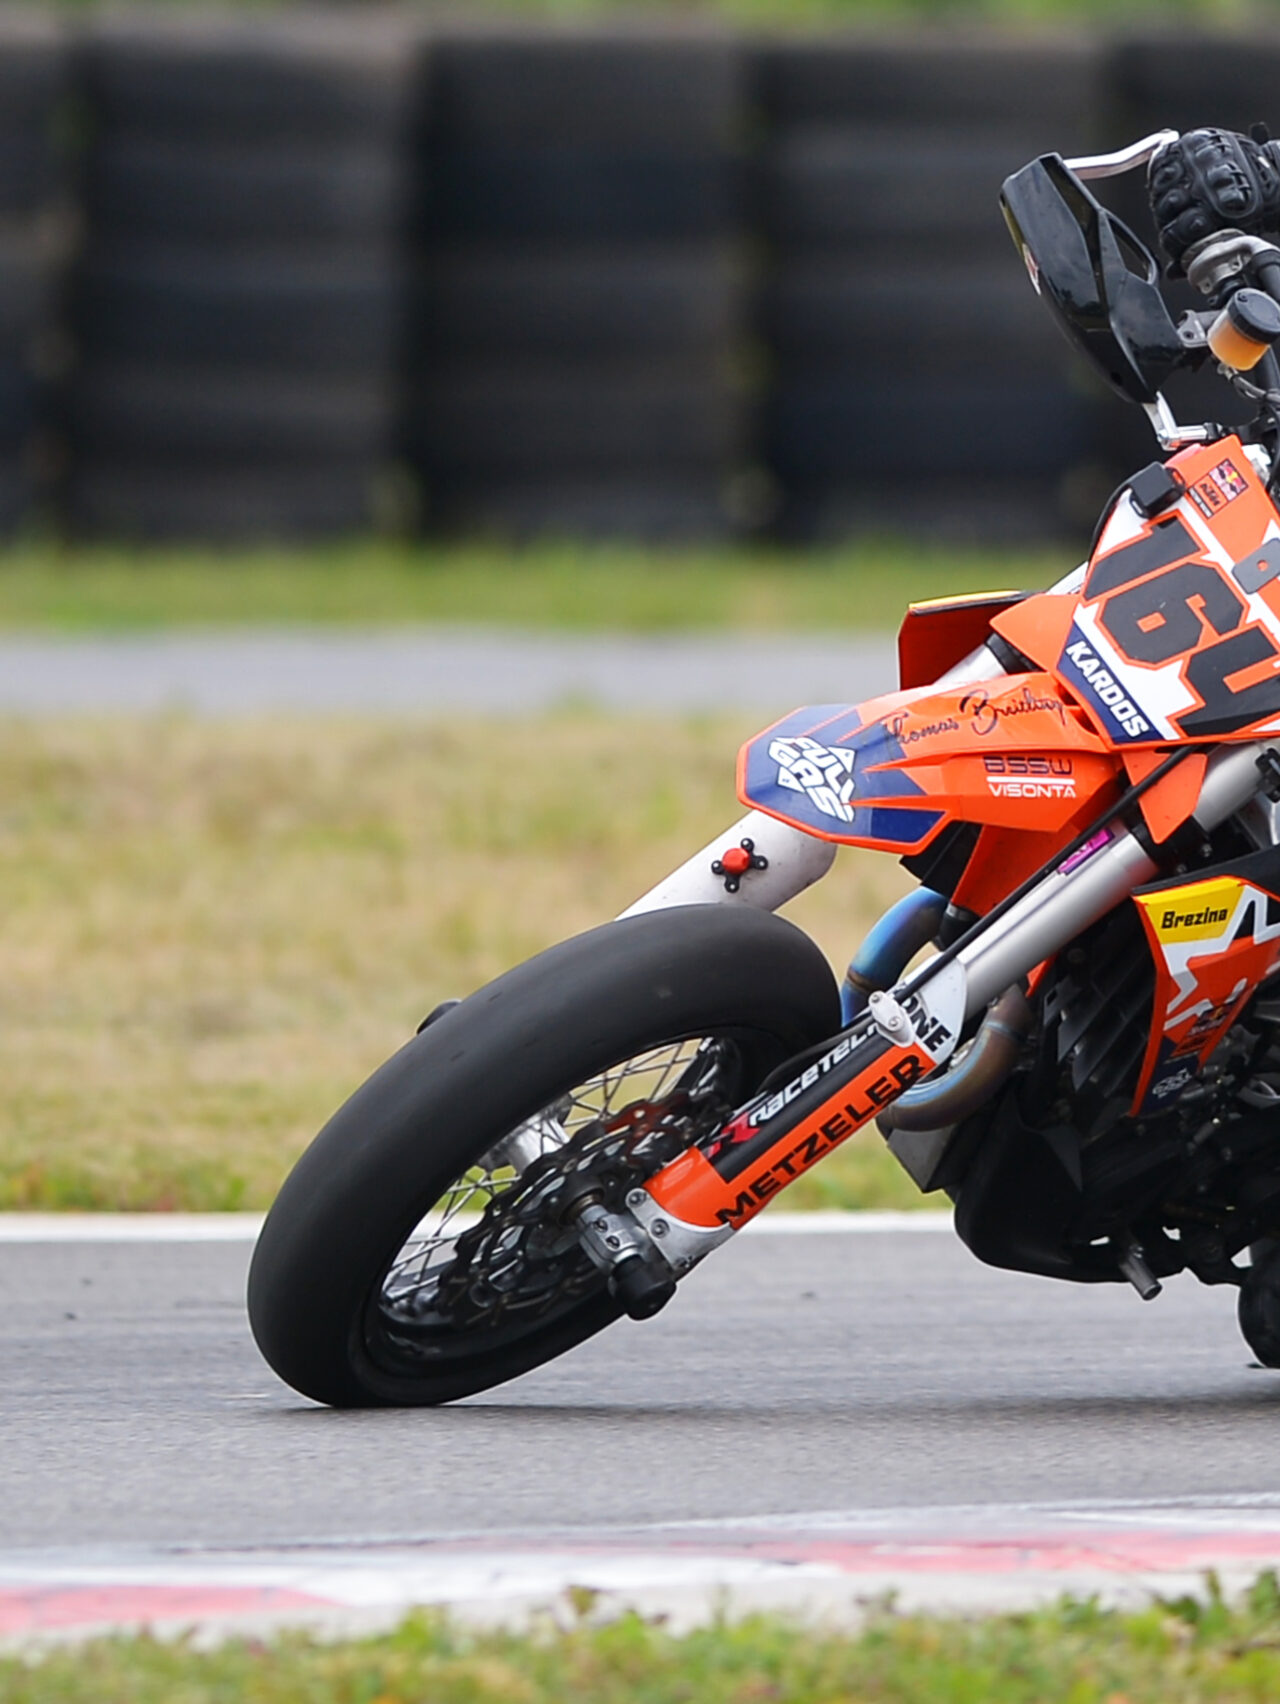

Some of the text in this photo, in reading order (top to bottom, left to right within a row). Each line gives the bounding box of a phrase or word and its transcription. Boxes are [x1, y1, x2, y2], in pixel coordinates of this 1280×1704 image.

[1064, 640, 1151, 739] KARDOS
[988, 783, 1077, 798] VISONTA
[715, 1054, 927, 1225] METZELER
